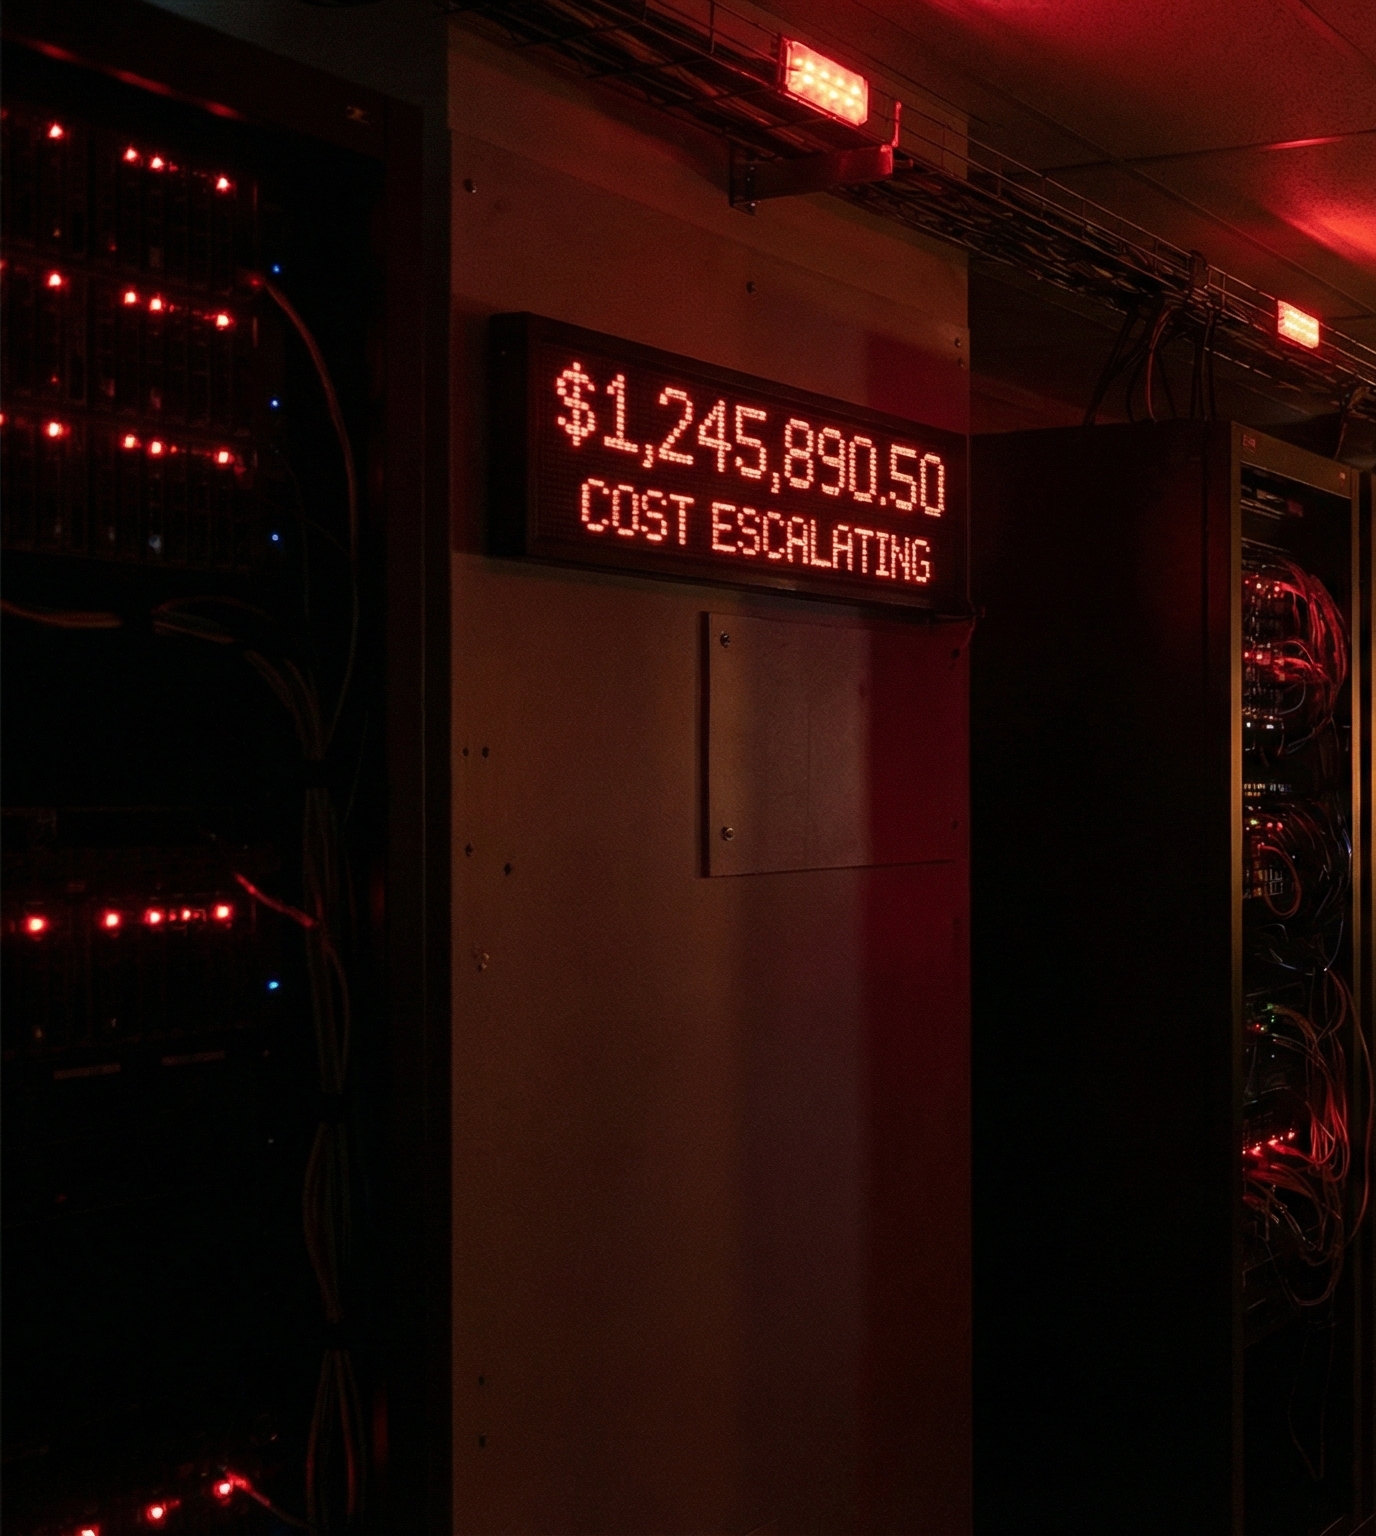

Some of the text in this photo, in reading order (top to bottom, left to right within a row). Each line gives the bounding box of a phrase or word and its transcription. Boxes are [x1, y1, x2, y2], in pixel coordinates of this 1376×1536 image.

[555, 361, 945, 517] $1,245,890.50
[581, 477, 930, 583] COST ESCALATING
